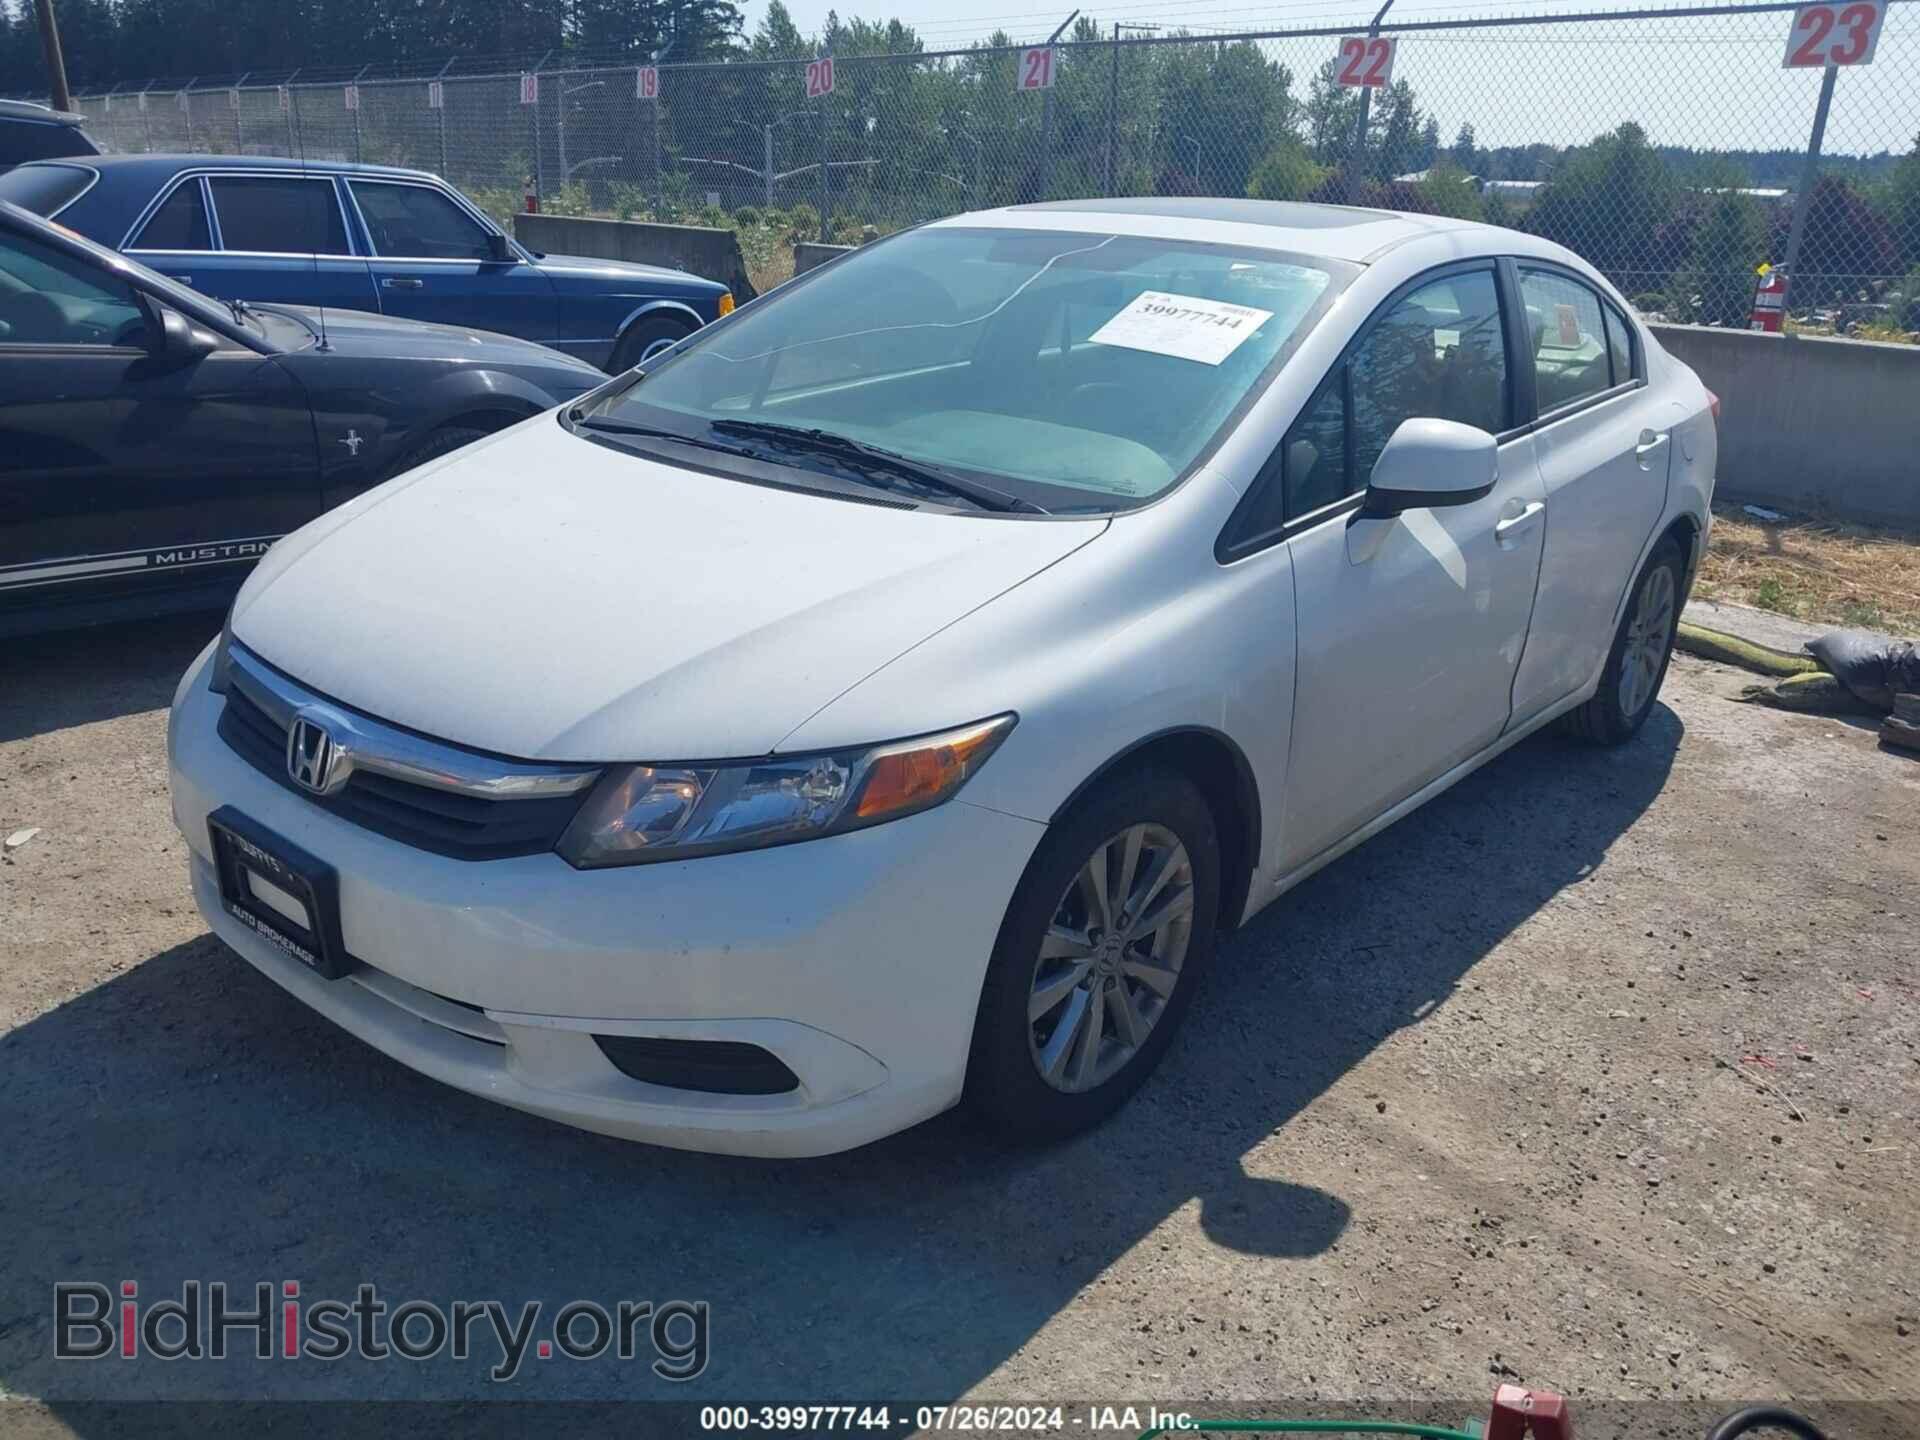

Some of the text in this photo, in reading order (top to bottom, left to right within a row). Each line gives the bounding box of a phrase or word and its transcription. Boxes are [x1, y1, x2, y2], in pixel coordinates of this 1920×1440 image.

[1790, 2, 1877, 65] 23
[806, 61, 833, 96] 20
[1023, 48, 1053, 89] 21
[1338, 39, 1391, 87] 22
[638, 68, 657, 98] 19
[1136, 303, 1244, 329] 39977744
[231, 904, 256, 929] AUTO
[256, 920, 316, 967] BROKERAGE
